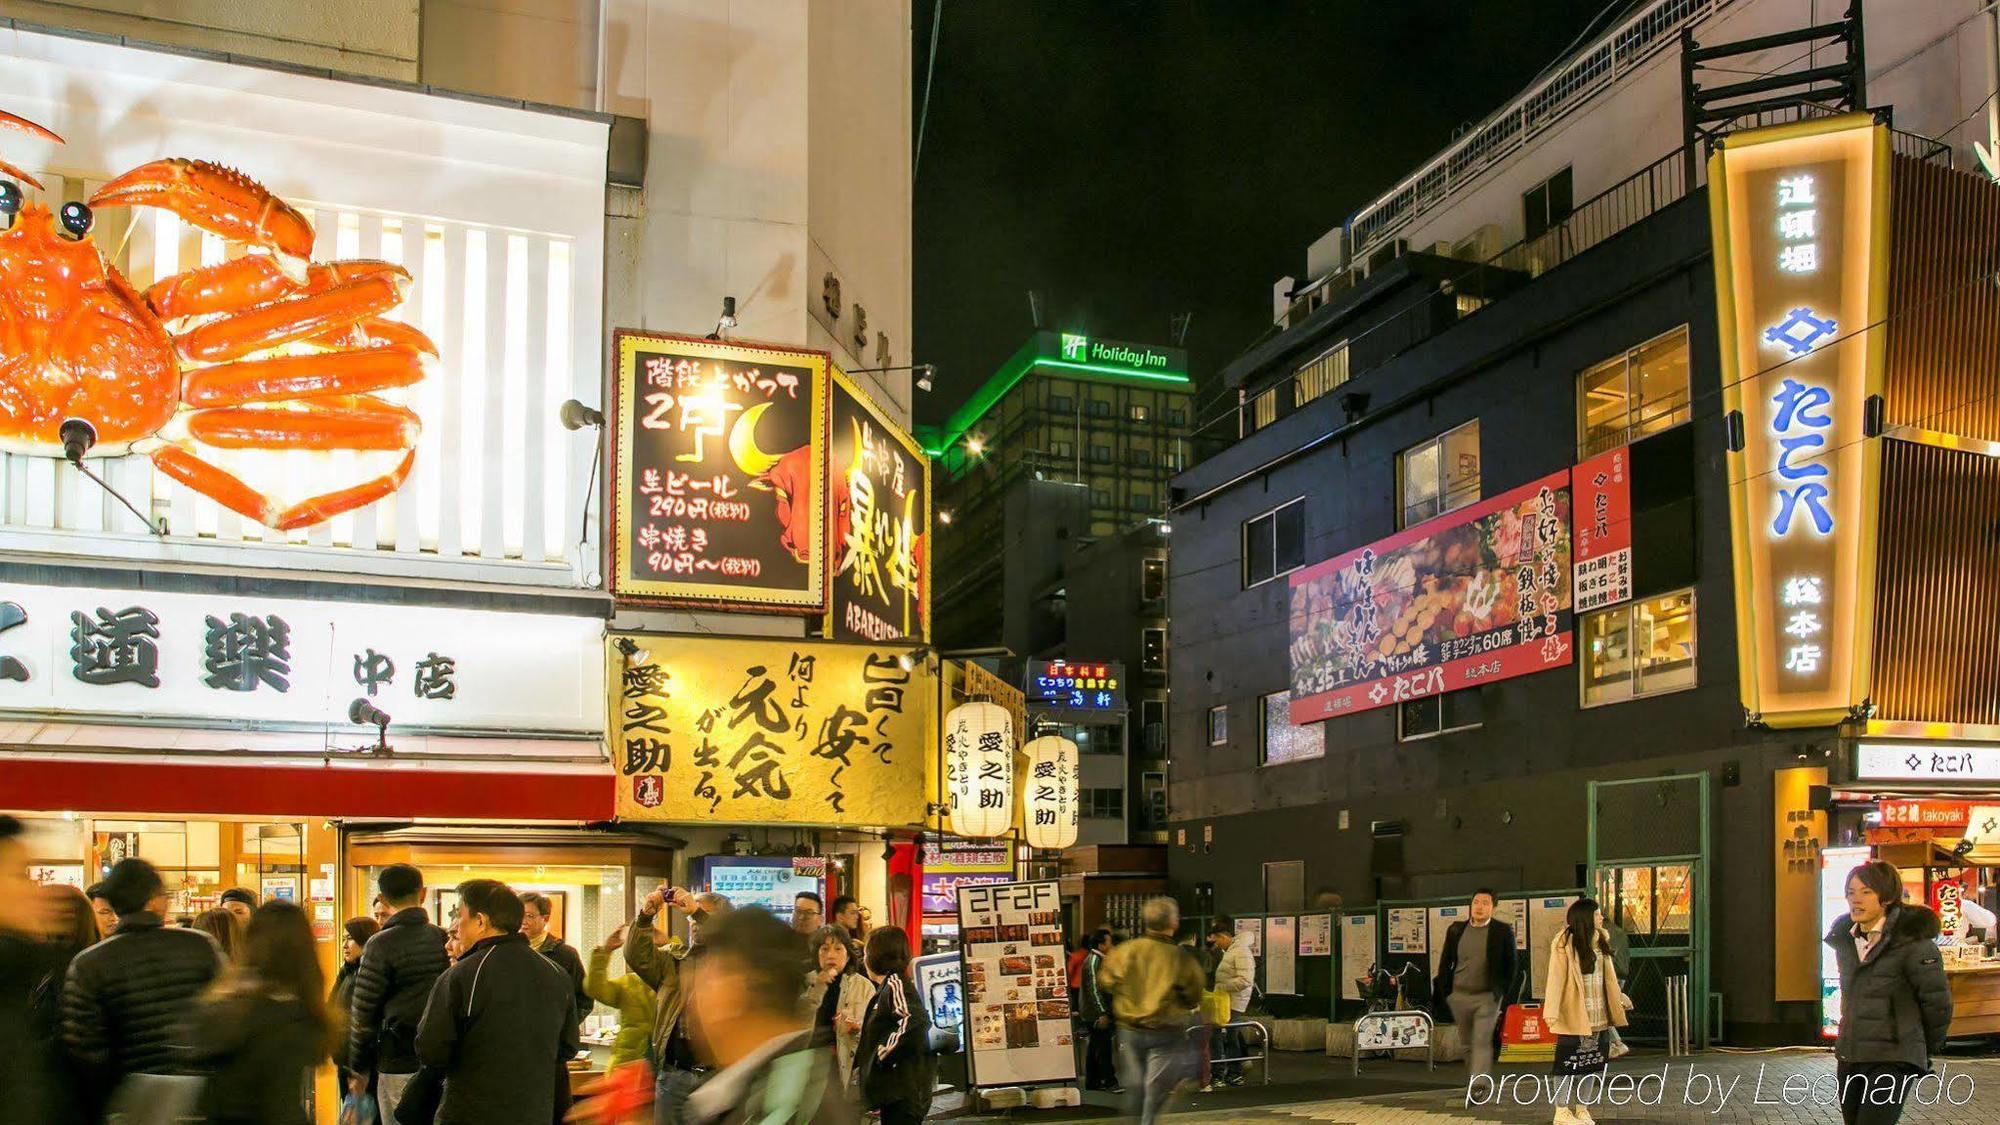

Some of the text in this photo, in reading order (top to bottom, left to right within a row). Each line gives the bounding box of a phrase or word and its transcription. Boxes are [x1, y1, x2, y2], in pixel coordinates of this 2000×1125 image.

[1778, 175, 1816, 273] 道頓堀
[1092, 343, 1167, 367] Holiday Inn
[1772, 378, 1834, 536] たこ八
[640, 468, 738, 498] 生ビール
[639, 523, 709, 551] 串焼き
[1594, 493, 1608, 538] たこ八
[1578, 563, 1588, 610] 鉄板焼
[1598, 557, 1608, 604] 明石焼
[1608, 555, 1618, 601] たこ焼
[1618, 551, 1628, 599] お好み焼
[1441, 635, 1481, 652] 2F カウンター
[1482, 629, 1512, 651] 60席
[1784, 576, 1821, 674] 総本店
[353, 648, 457, 701] 中店
[1441, 644, 1481, 662] 3F テーブル
[787, 651, 816, 742] 何より
[1393, 666, 1445, 702] たこ八
[622, 662, 672, 776] 愛之助
[725, 665, 791, 800] 元気
[864, 652, 911, 766] 旨くて
[810, 703, 870, 814] 安くて
[957, 720, 969, 795] 炭火やきとり
[978, 731, 1004, 808] 愛之助
[1931, 752, 1973, 773] たこ八
[1034, 760, 1056, 825] 愛之助
[1057, 751, 1068, 813] 炭火やきとり
[1922, 809, 1964, 823] takoyaki
[969, 884, 1051, 912] 2F2F
